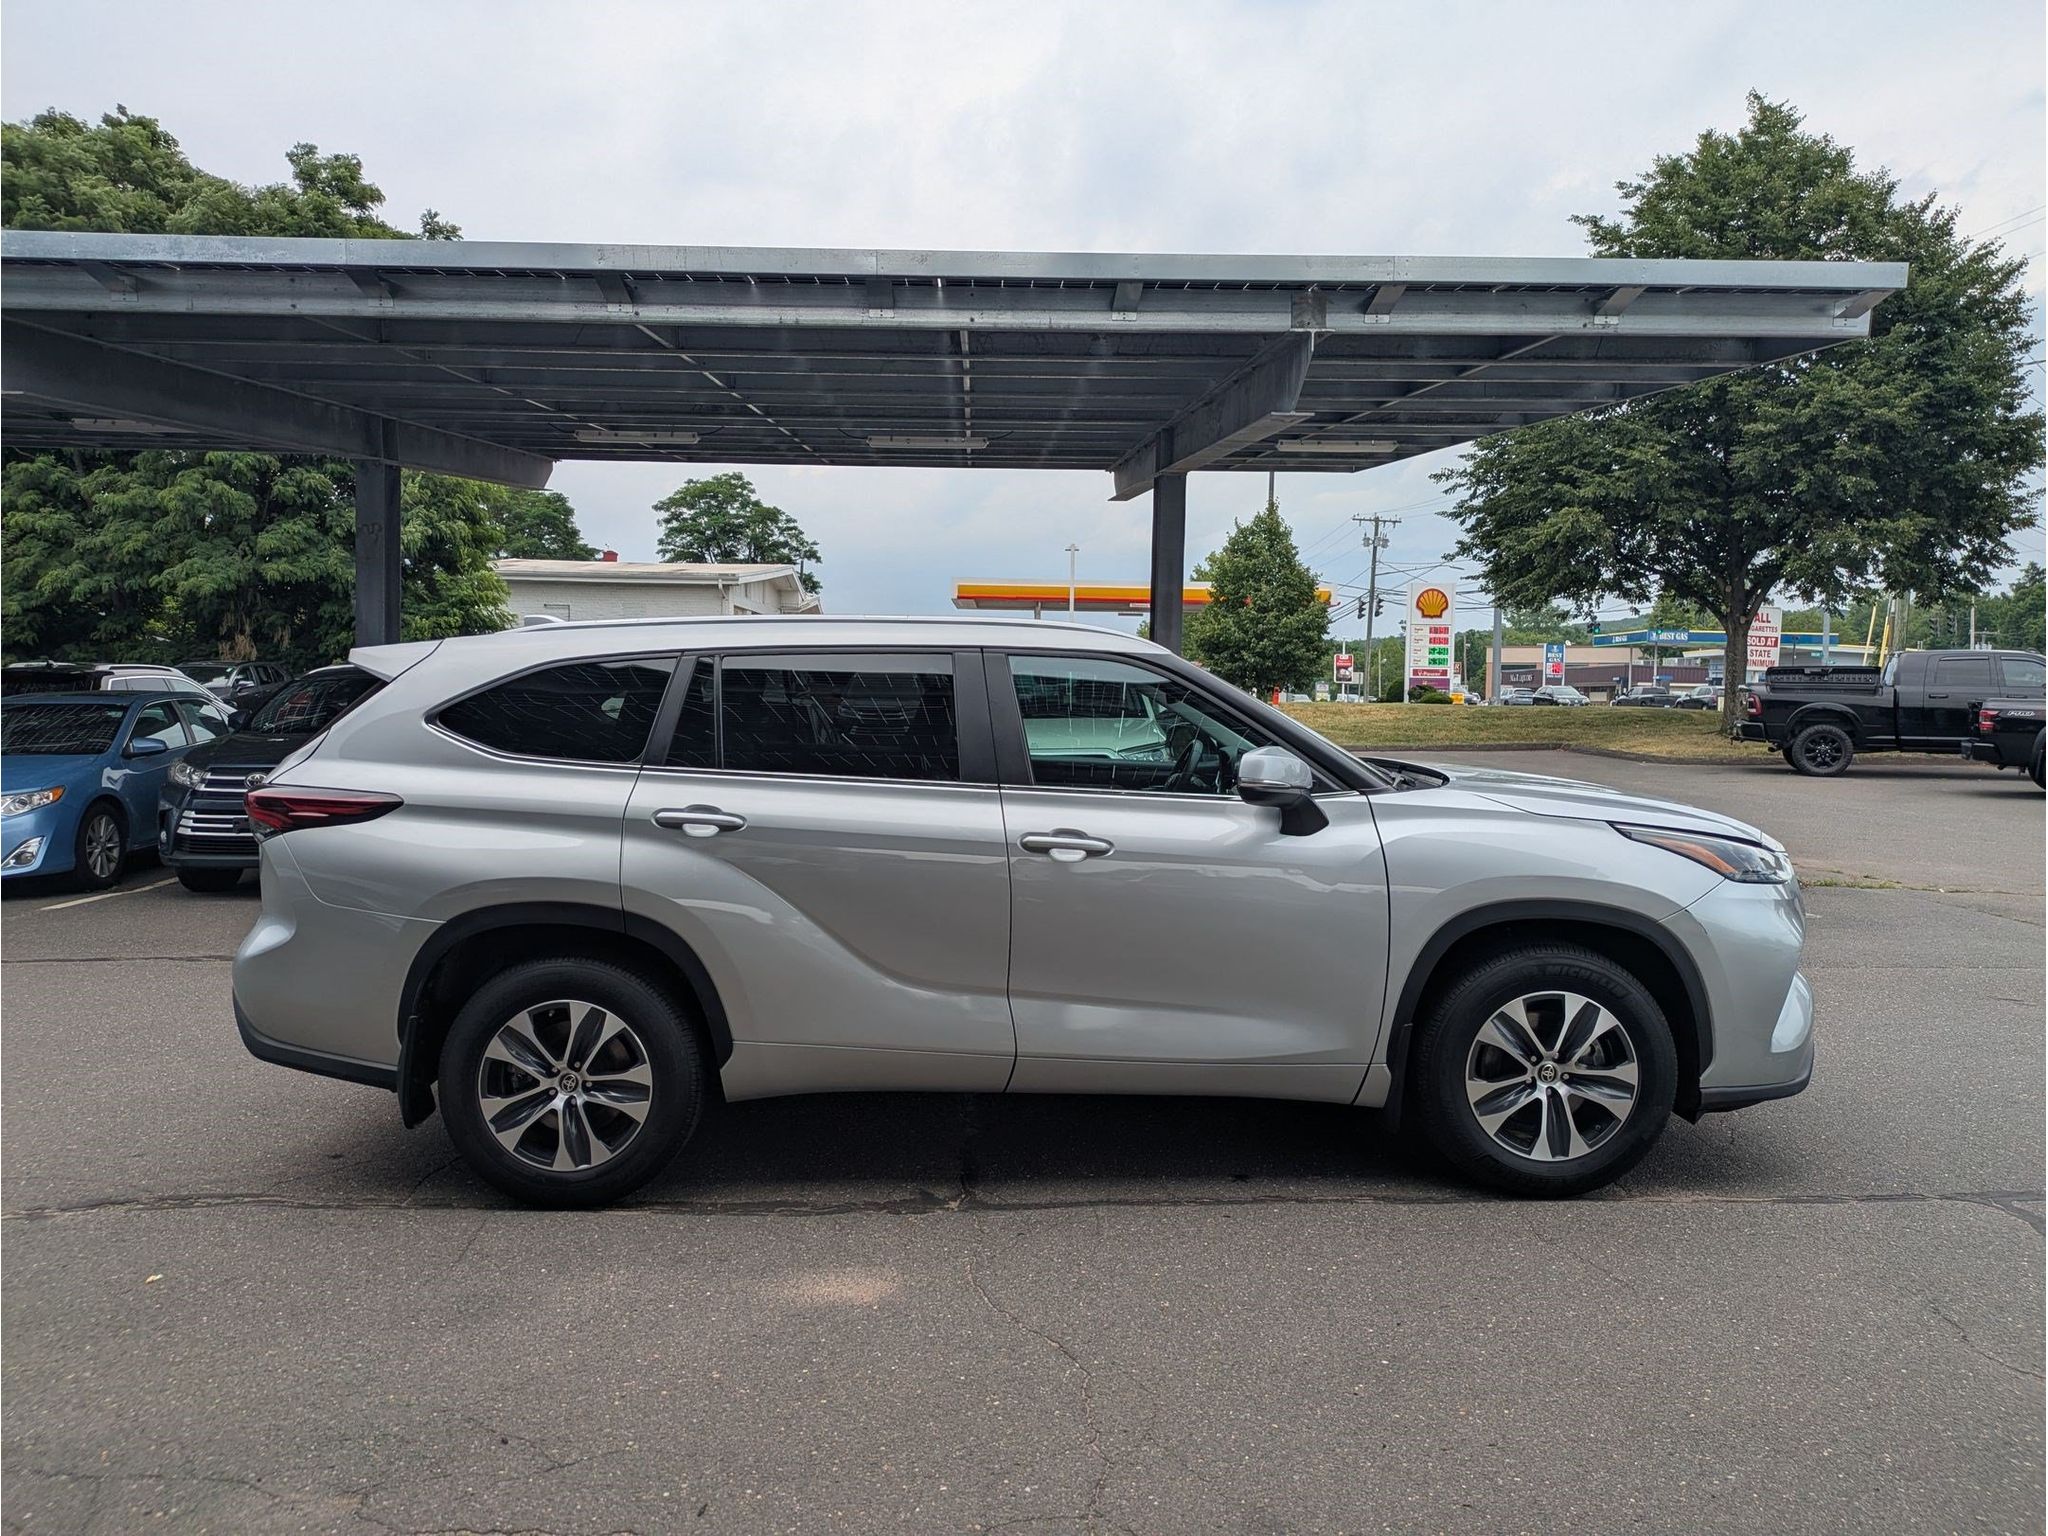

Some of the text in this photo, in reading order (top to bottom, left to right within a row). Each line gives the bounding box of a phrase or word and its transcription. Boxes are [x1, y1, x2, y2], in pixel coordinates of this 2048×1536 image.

[1754, 613, 1771, 623] ALL
[1751, 625, 1778, 633] GARETTES
[1659, 632, 1688, 640] BEST GAS
[1747, 636, 1776, 646] SOLD AT
[1749, 649, 1771, 658] STATE
